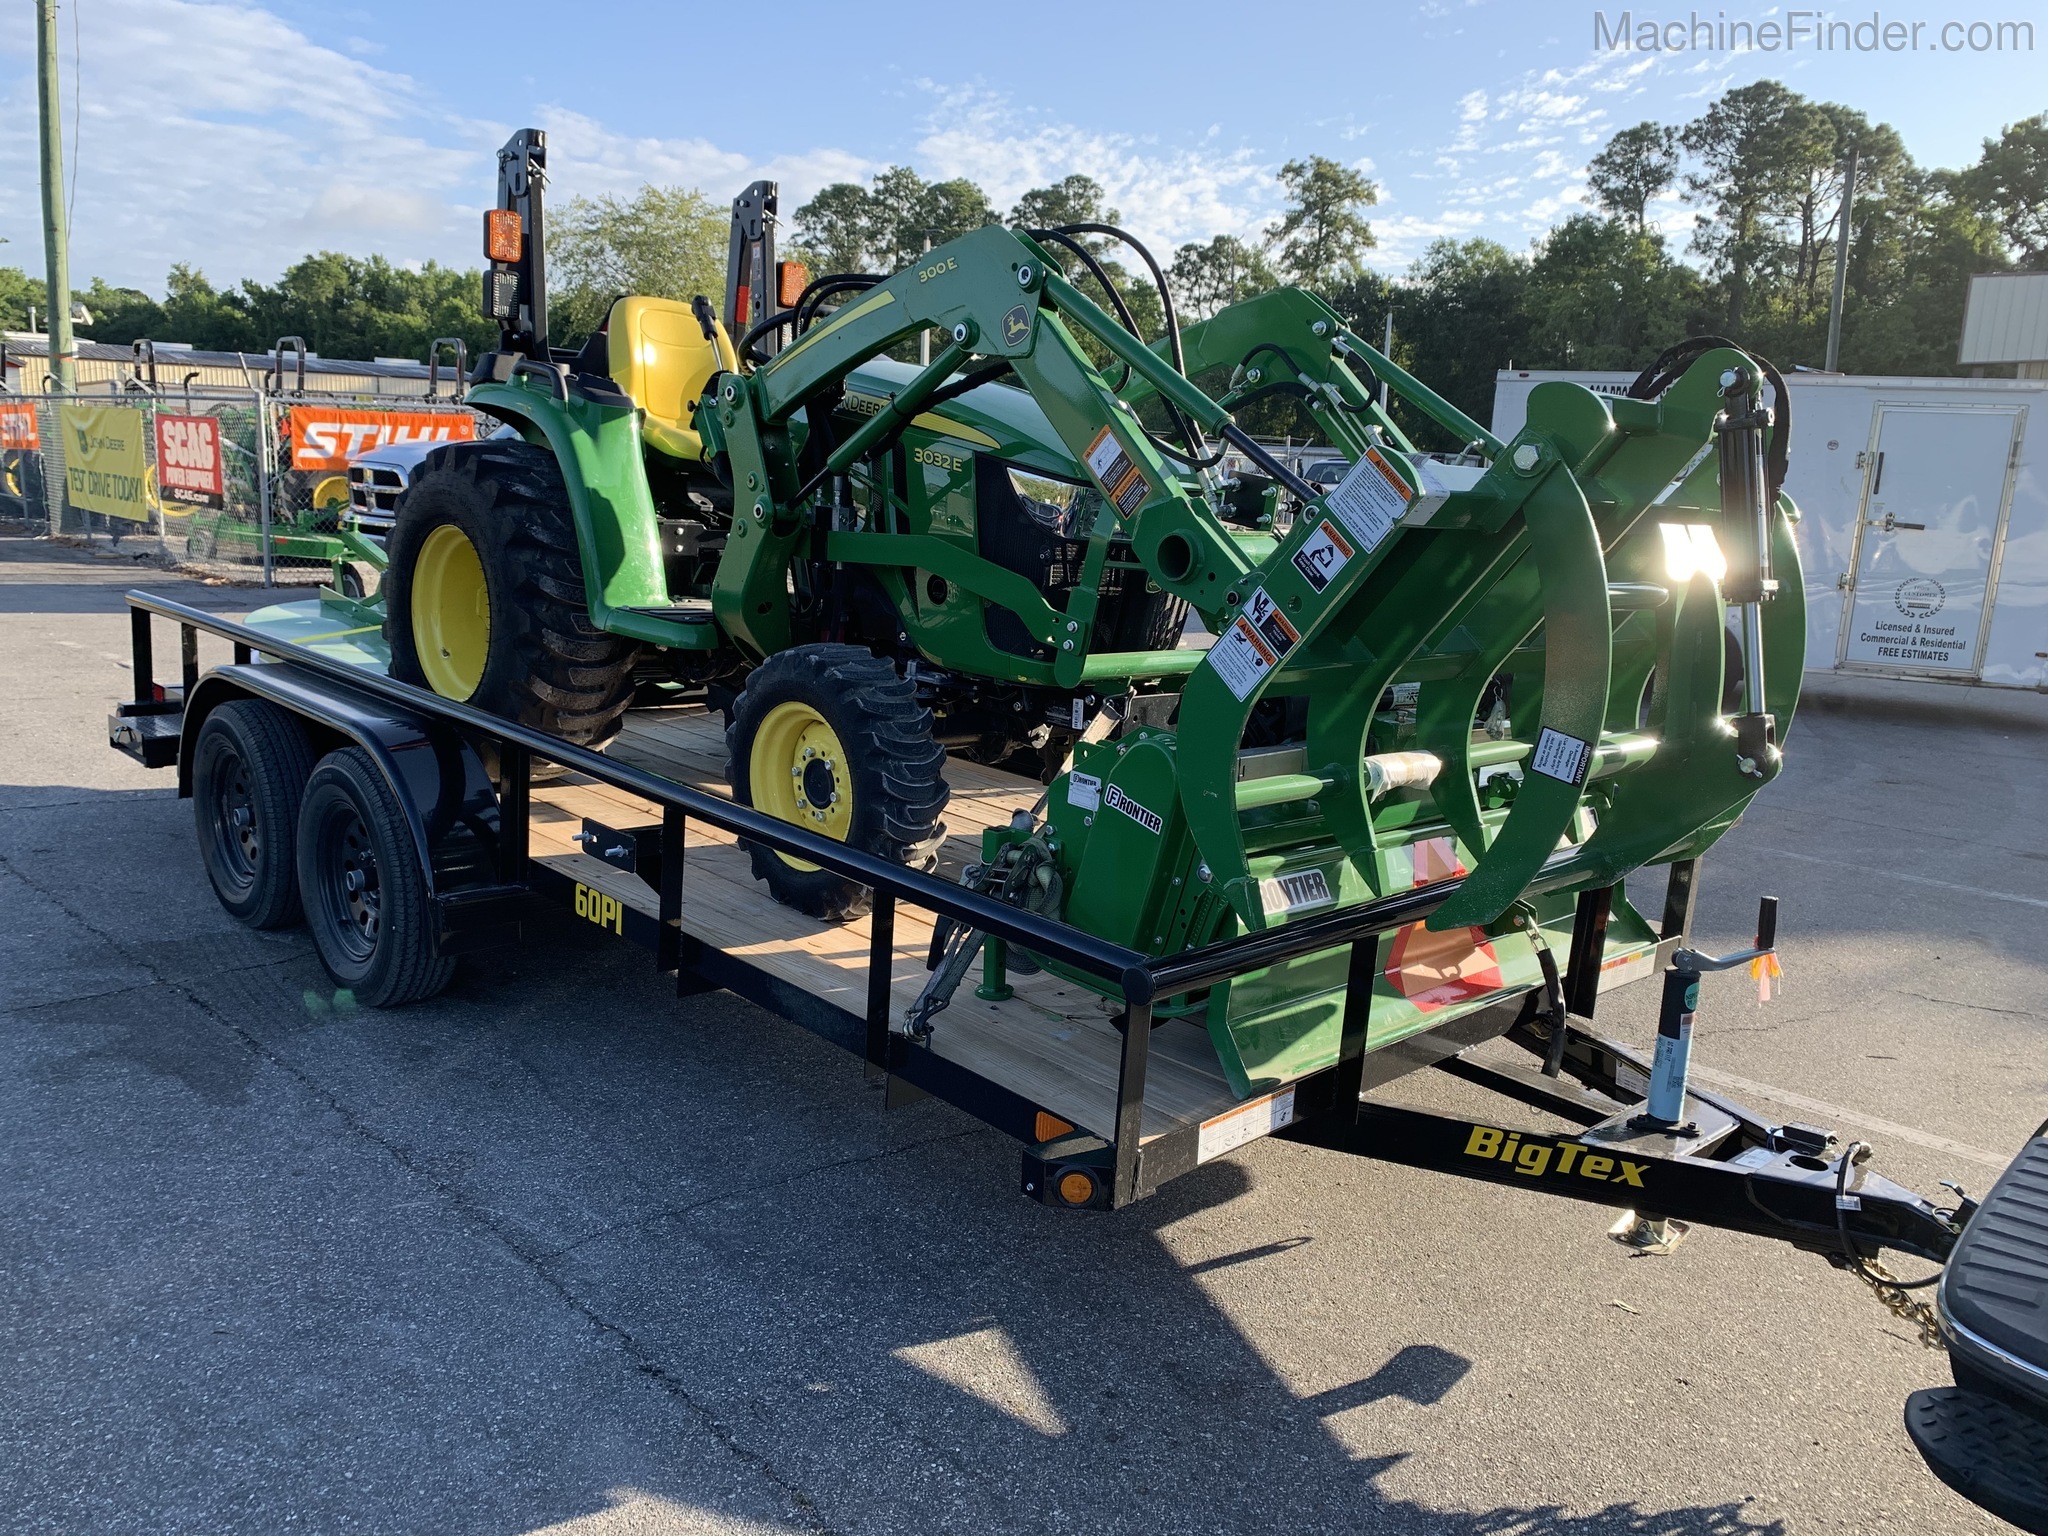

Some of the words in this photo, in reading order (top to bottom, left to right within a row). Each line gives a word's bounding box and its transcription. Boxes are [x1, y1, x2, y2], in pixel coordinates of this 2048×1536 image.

[918, 256, 958, 283] 300E
[850, 395, 884, 417] DEER
[162, 420, 214, 470] SCAG
[913, 447, 964, 473] 3032E
[69, 466, 86, 493] TEST
[88, 470, 111, 499] DRIVE
[112, 474, 143, 504] TODAY!
[1379, 463, 1407, 494] WARNING
[1328, 531, 1351, 556] WARNING
[1861, 632, 1909, 645] Commercial
[1911, 636, 1917, 646] &
[1920, 637, 1966, 650] Residential
[1875, 621, 1912, 632] Licensed
[1915, 624, 1920, 633] &
[1923, 624, 1955, 636] Insured
[1245, 630, 1273, 662] WARNING
[1878, 647, 1899, 657] FREE
[1901, 648, 1949, 661] ESTIMATES
[1574, 745, 1591, 784] IMPORTANT
[1105, 784, 1161, 833] FRONTIER
[1260, 872, 1328, 911] RONTIER
[575, 882, 622, 936] 60PI
[1463, 1125, 1651, 1188] BigTex
